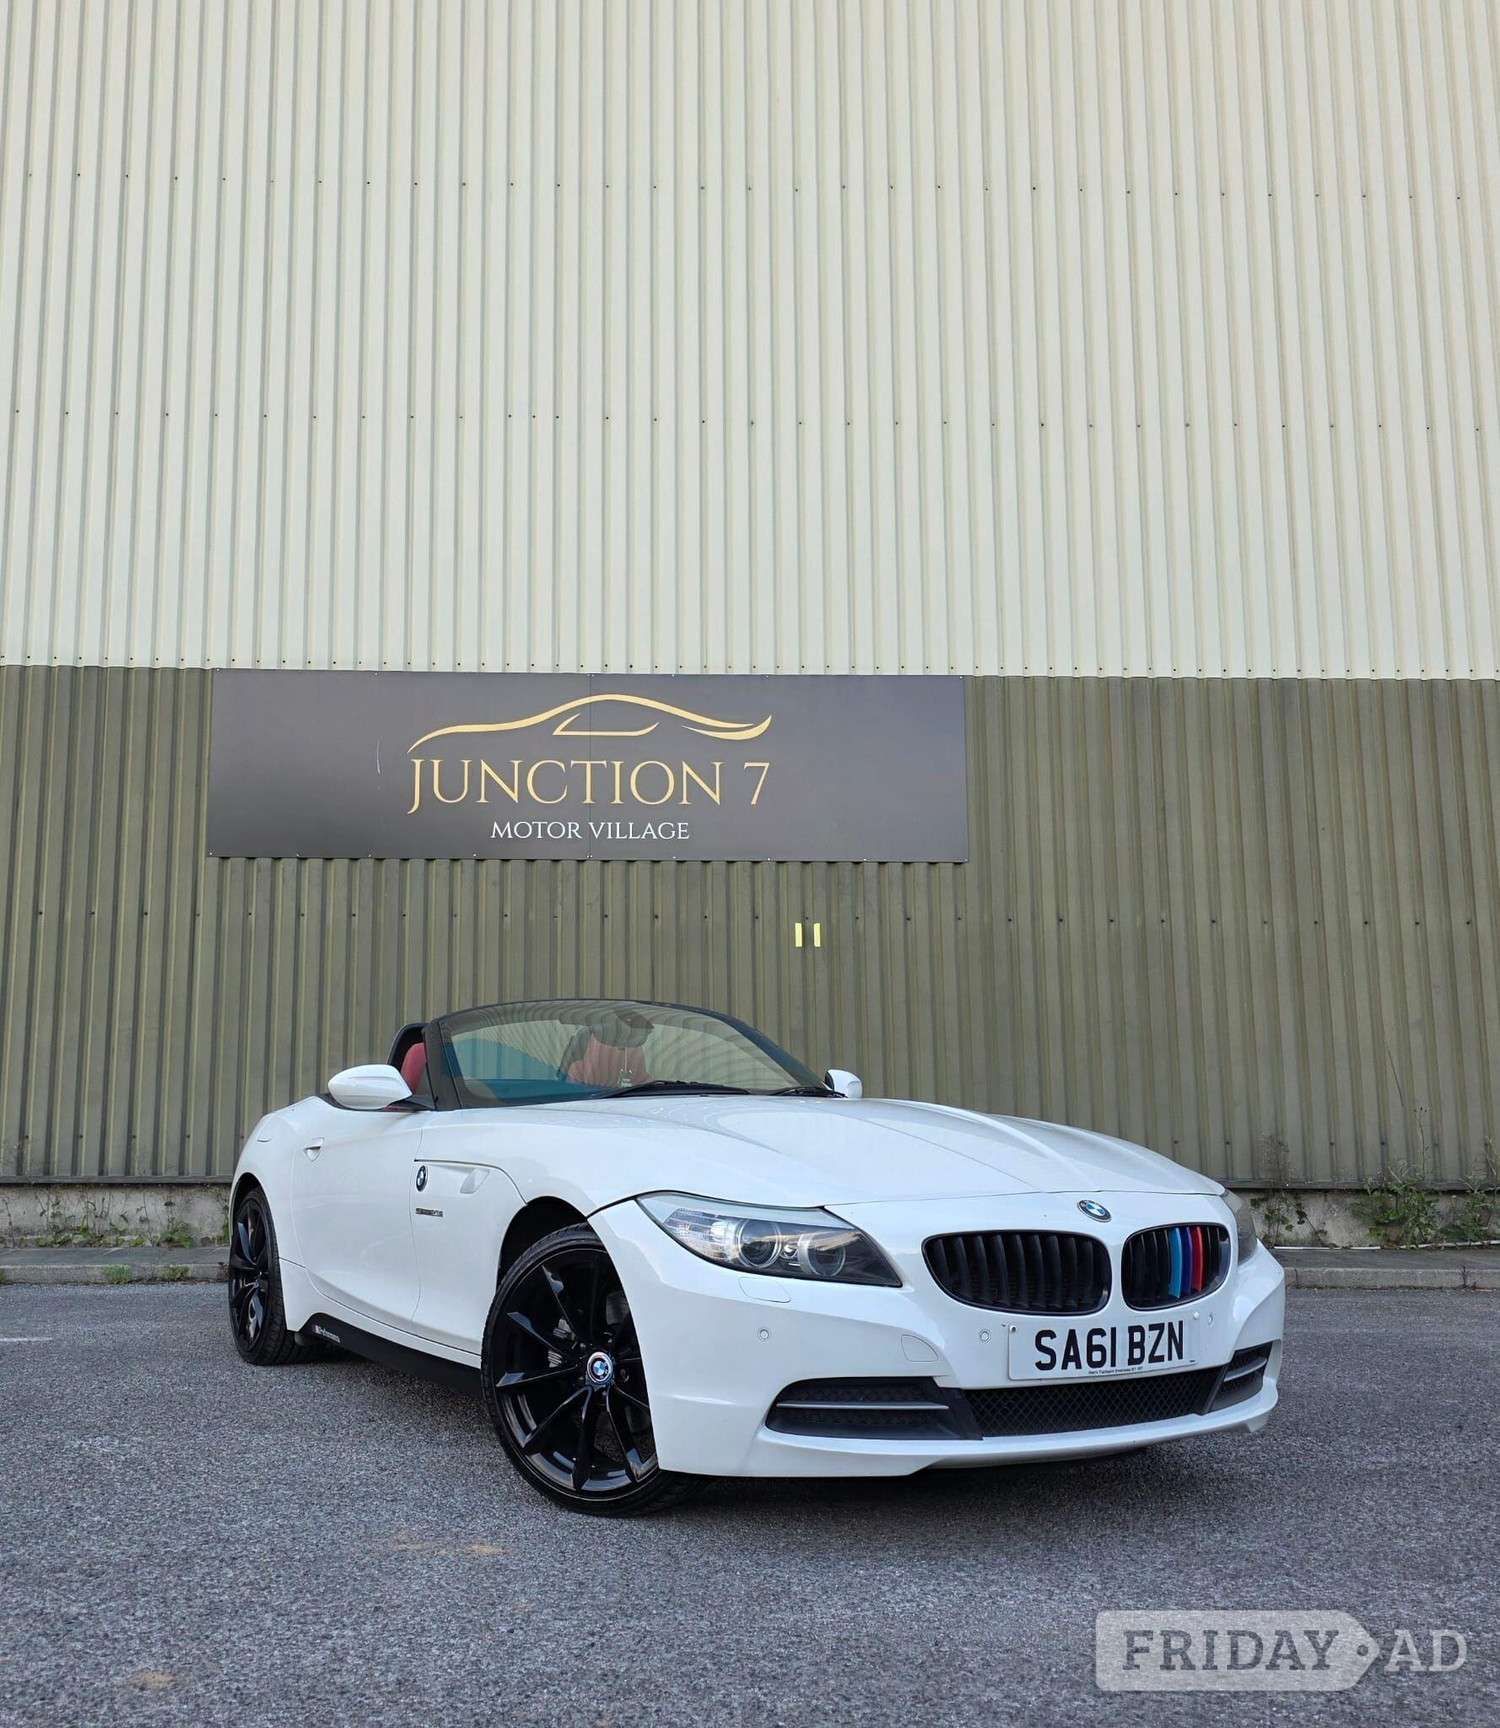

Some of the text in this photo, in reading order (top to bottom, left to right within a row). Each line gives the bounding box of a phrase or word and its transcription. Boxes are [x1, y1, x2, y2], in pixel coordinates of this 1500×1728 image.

[407, 759, 770, 814] JUNCTION 7
[490, 821, 690, 840] MOTOR VILLAGE
[1034, 1320, 1184, 1371] SA61 BZN
